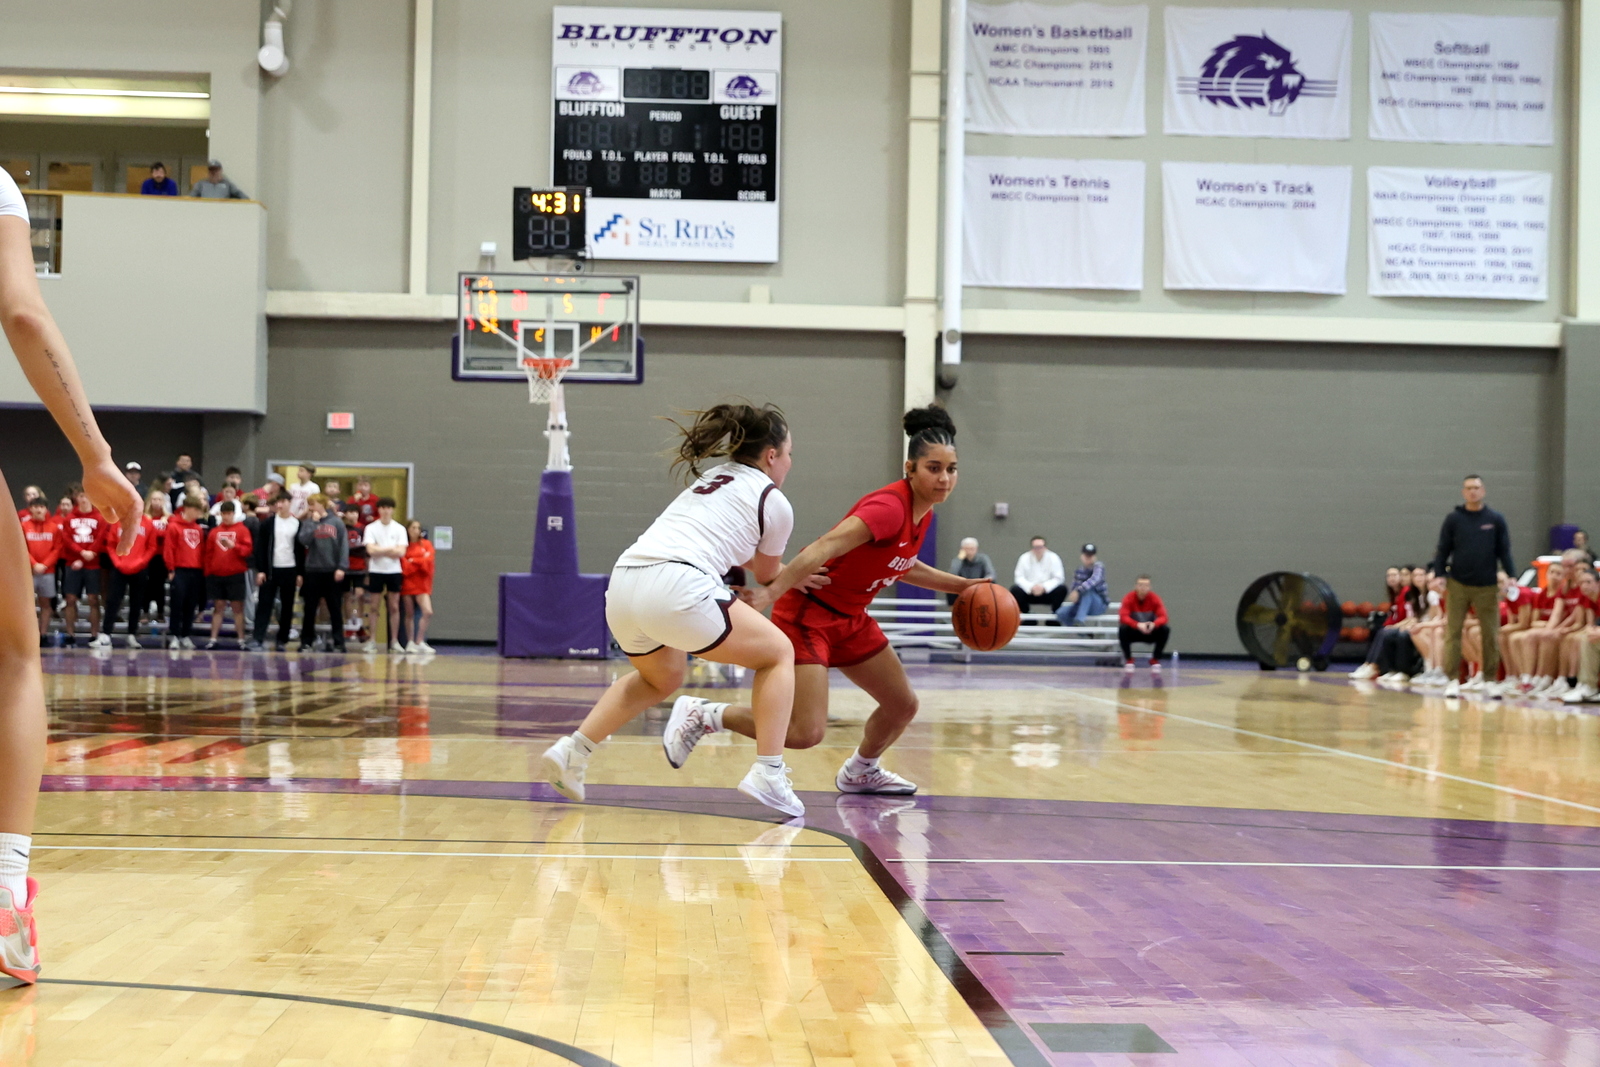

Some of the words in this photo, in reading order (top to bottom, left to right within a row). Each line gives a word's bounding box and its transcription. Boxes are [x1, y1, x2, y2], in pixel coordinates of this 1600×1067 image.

[557, 24, 777, 46] BLUFFTON
[972, 22, 1045, 38] Women's
[1051, 24, 1133, 40] Basketball
[570, 41, 753, 51] UNIVERSITY
[1433, 41, 1490, 55] Softball
[559, 101, 625, 117] BLUFFTON
[649, 110, 682, 122] PERIOD
[720, 105, 764, 120] GUEST
[563, 149, 592, 161] FOULS
[601, 150, 626, 162] T.O.L.
[634, 152, 668, 163] PLAYER
[672, 152, 696, 163] FOUL
[703, 153, 728, 164] T.O.L.
[737, 153, 767, 165] FOULS
[988, 173, 1057, 188] Women's
[1062, 175, 1110, 189] Tennis
[1196, 178, 1268, 193] Women's
[1273, 180, 1315, 195] Track
[1424, 175, 1497, 190] Volleyball
[649, 188, 681, 199] MATCH
[737, 190, 767, 201] SCORE
[532, 191, 580, 215] 4:31
[693, 474, 735, 495] 3
